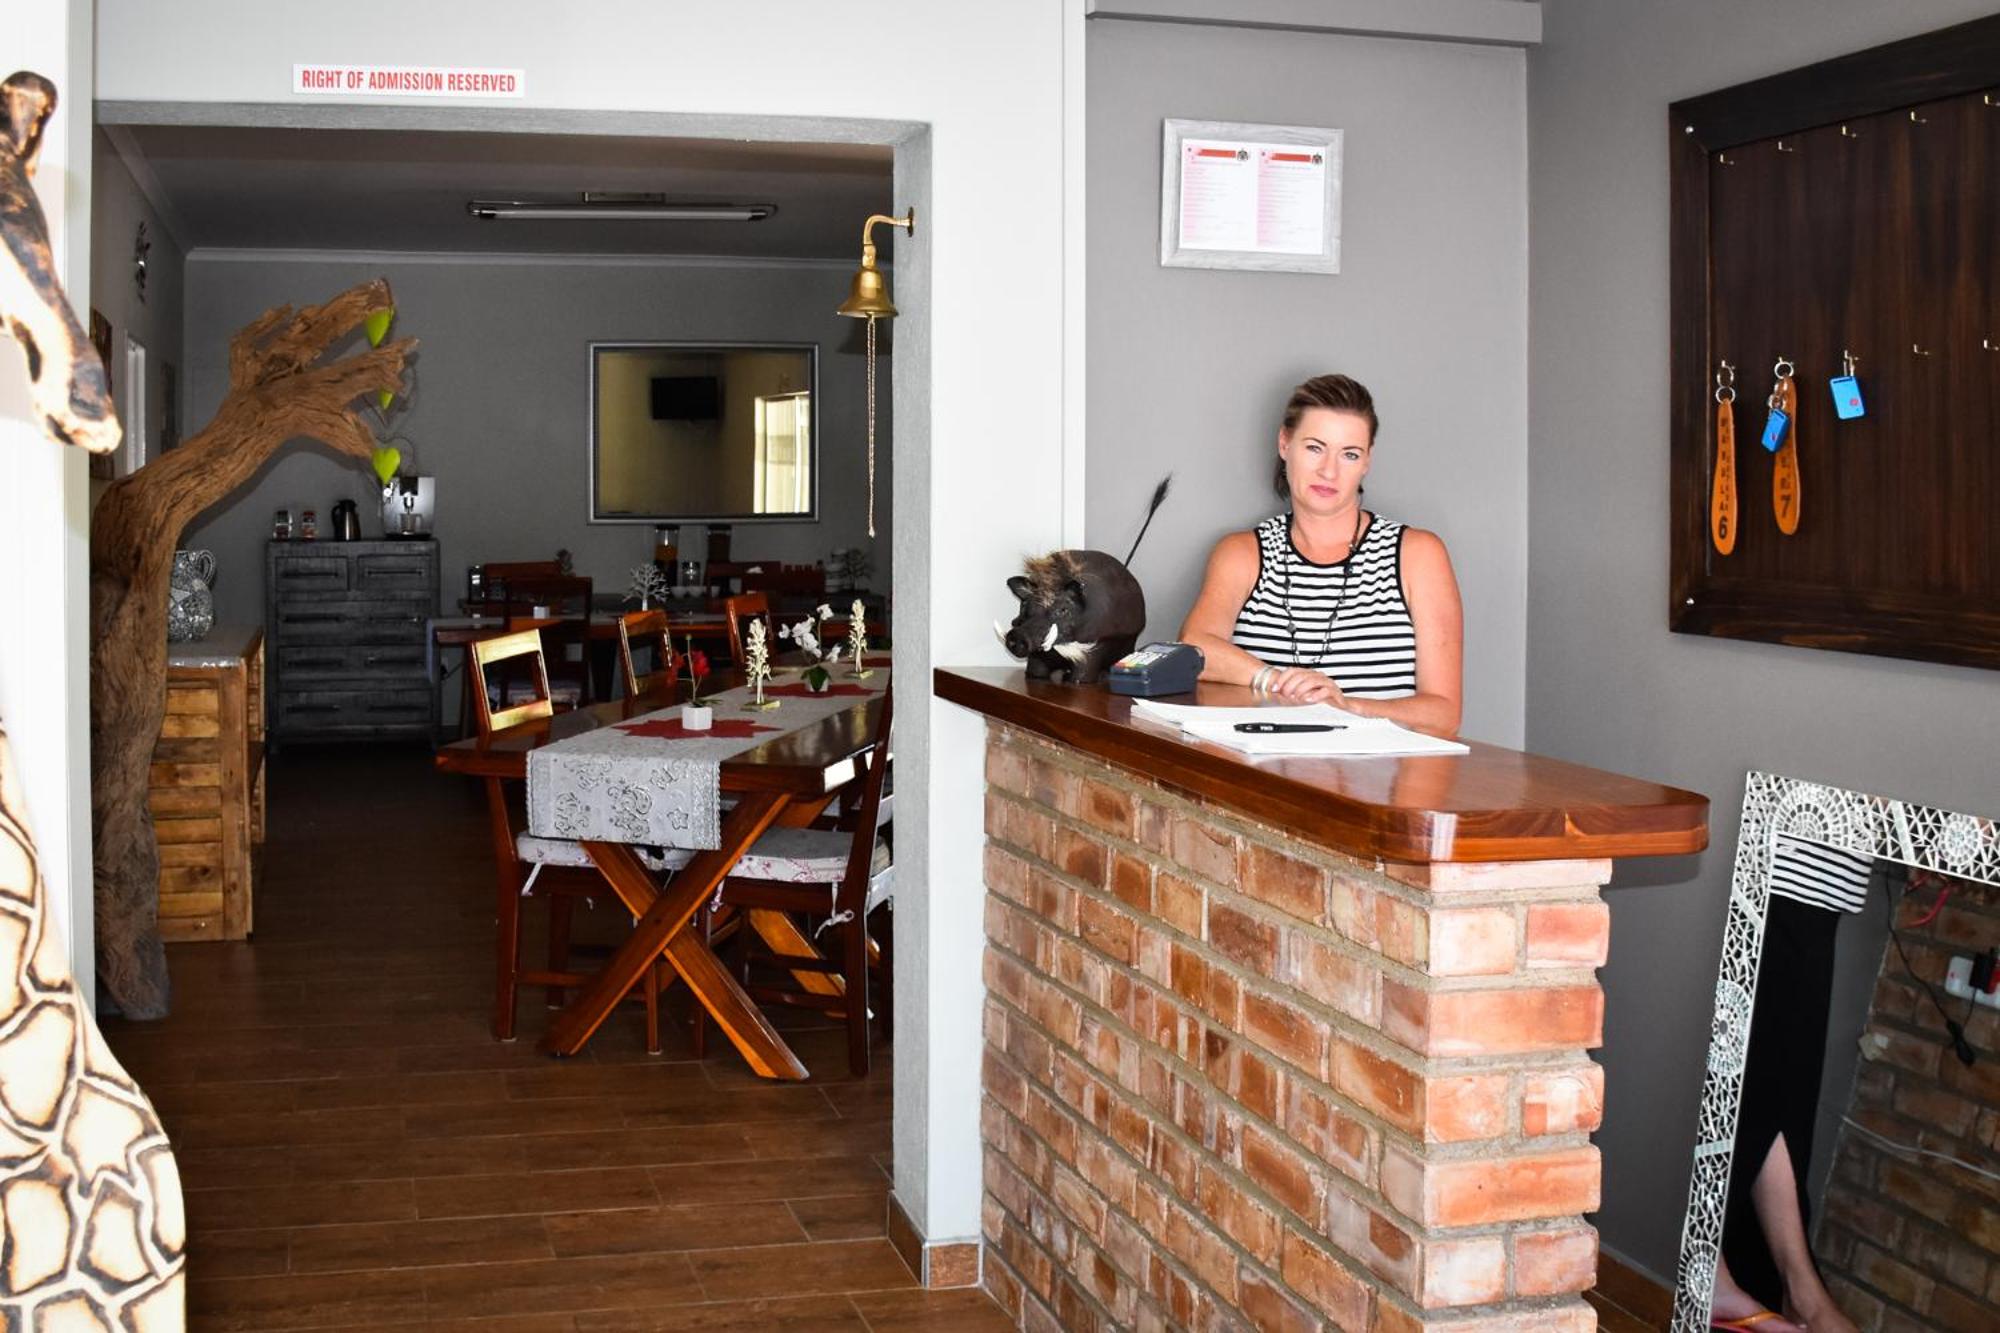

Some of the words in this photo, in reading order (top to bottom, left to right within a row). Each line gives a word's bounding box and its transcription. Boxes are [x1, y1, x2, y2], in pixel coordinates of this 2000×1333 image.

[302, 69, 342, 88] RIGHT
[347, 71, 364, 89] OF
[368, 71, 443, 91] ADMISSION
[448, 73, 516, 92] RESERVED
[1781, 494, 1791, 518] 7
[1718, 515, 1728, 540] 6
